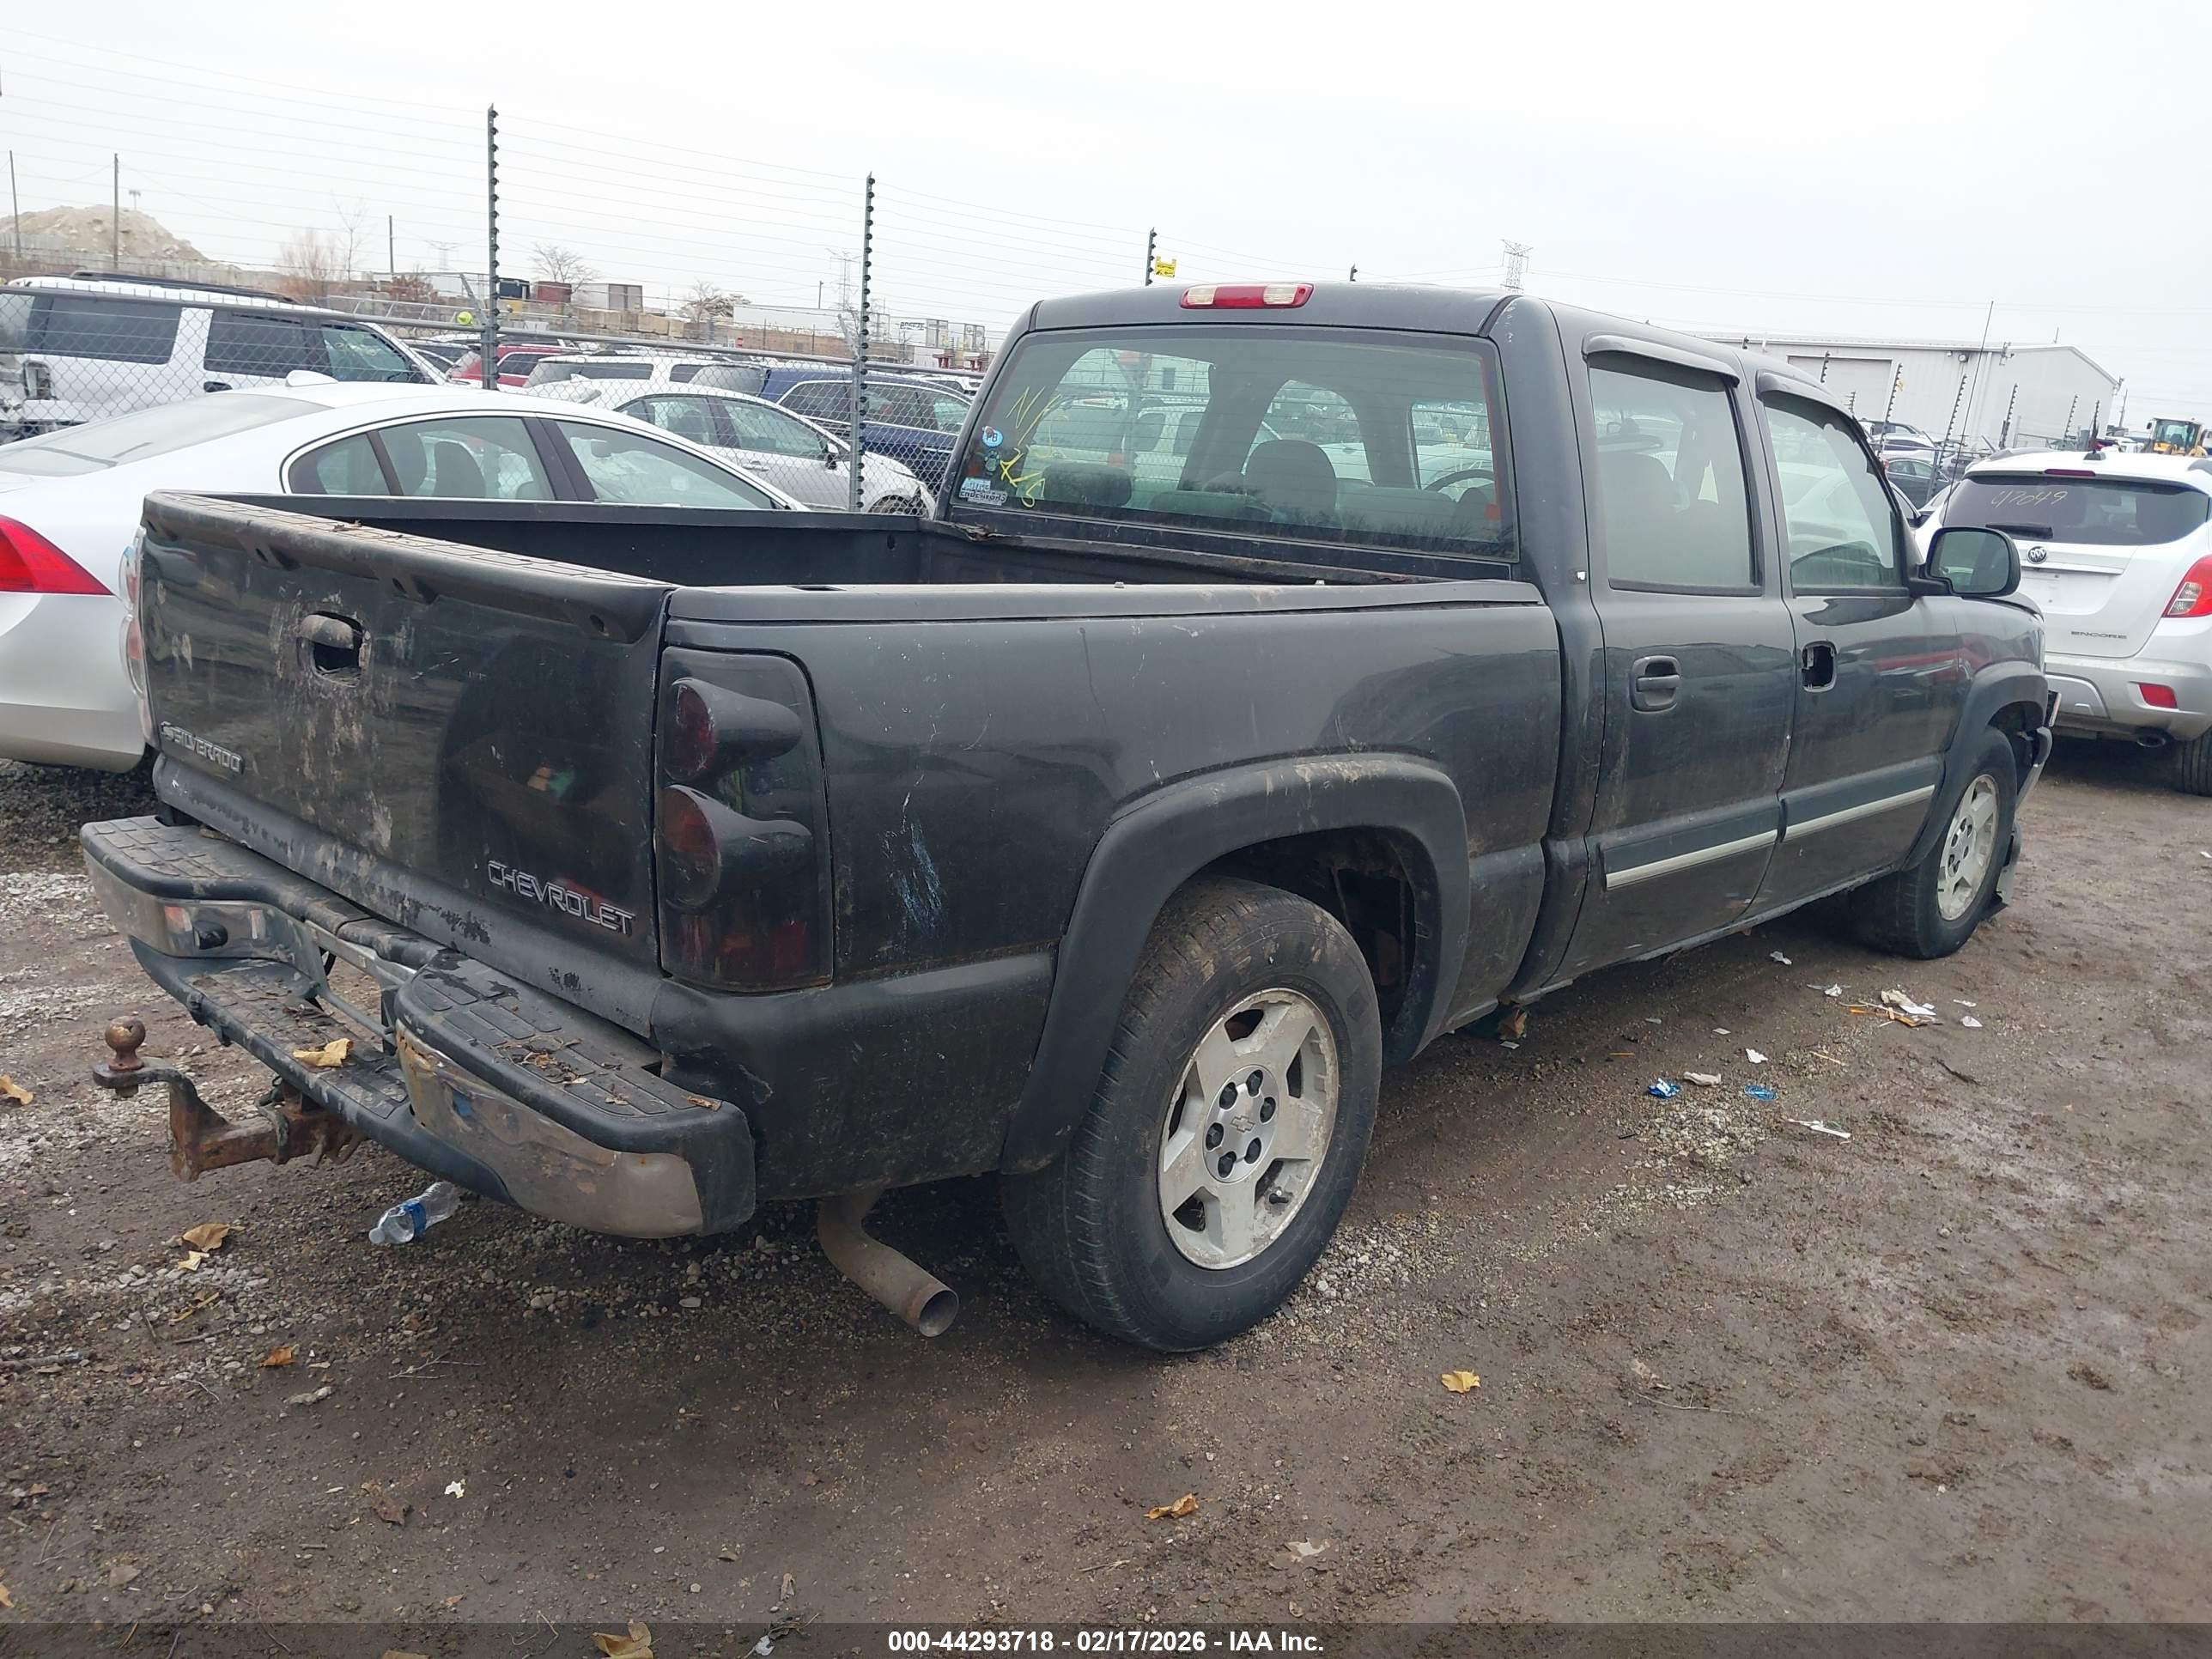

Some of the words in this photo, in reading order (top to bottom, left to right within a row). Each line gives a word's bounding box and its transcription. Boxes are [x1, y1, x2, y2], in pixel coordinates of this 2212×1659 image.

[2070, 630, 2128, 640] ENCORE
[161, 720, 244, 774] SILVERADO
[488, 860, 637, 937] CHEVROLET
